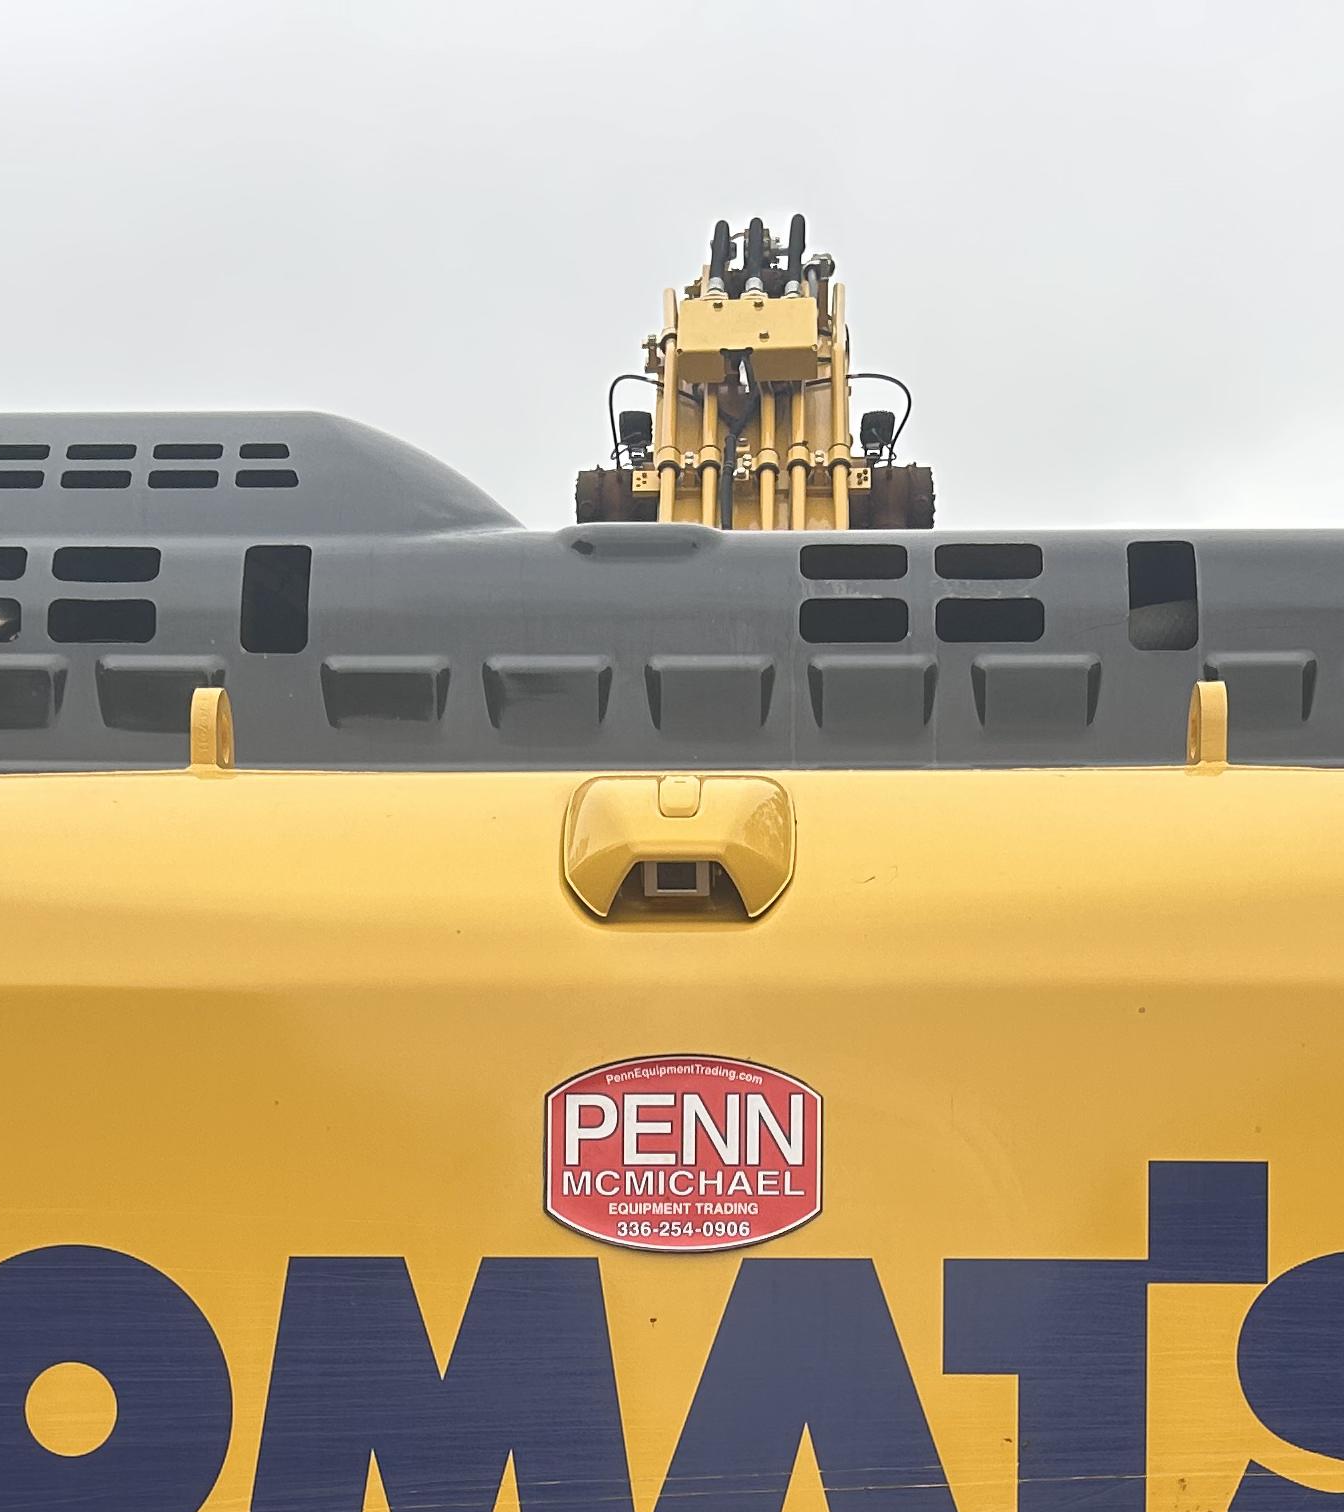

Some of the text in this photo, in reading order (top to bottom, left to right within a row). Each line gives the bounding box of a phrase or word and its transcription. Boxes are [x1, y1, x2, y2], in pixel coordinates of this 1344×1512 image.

[606, 1064, 763, 1085] PennEquipmentTrading.com
[565, 1093, 804, 1166] PENN
[562, 1170, 805, 1196] MCMICHAEL
[608, 1202, 759, 1215] EQUIPMENT TRADING
[617, 1221, 750, 1238] 336-254-0906
